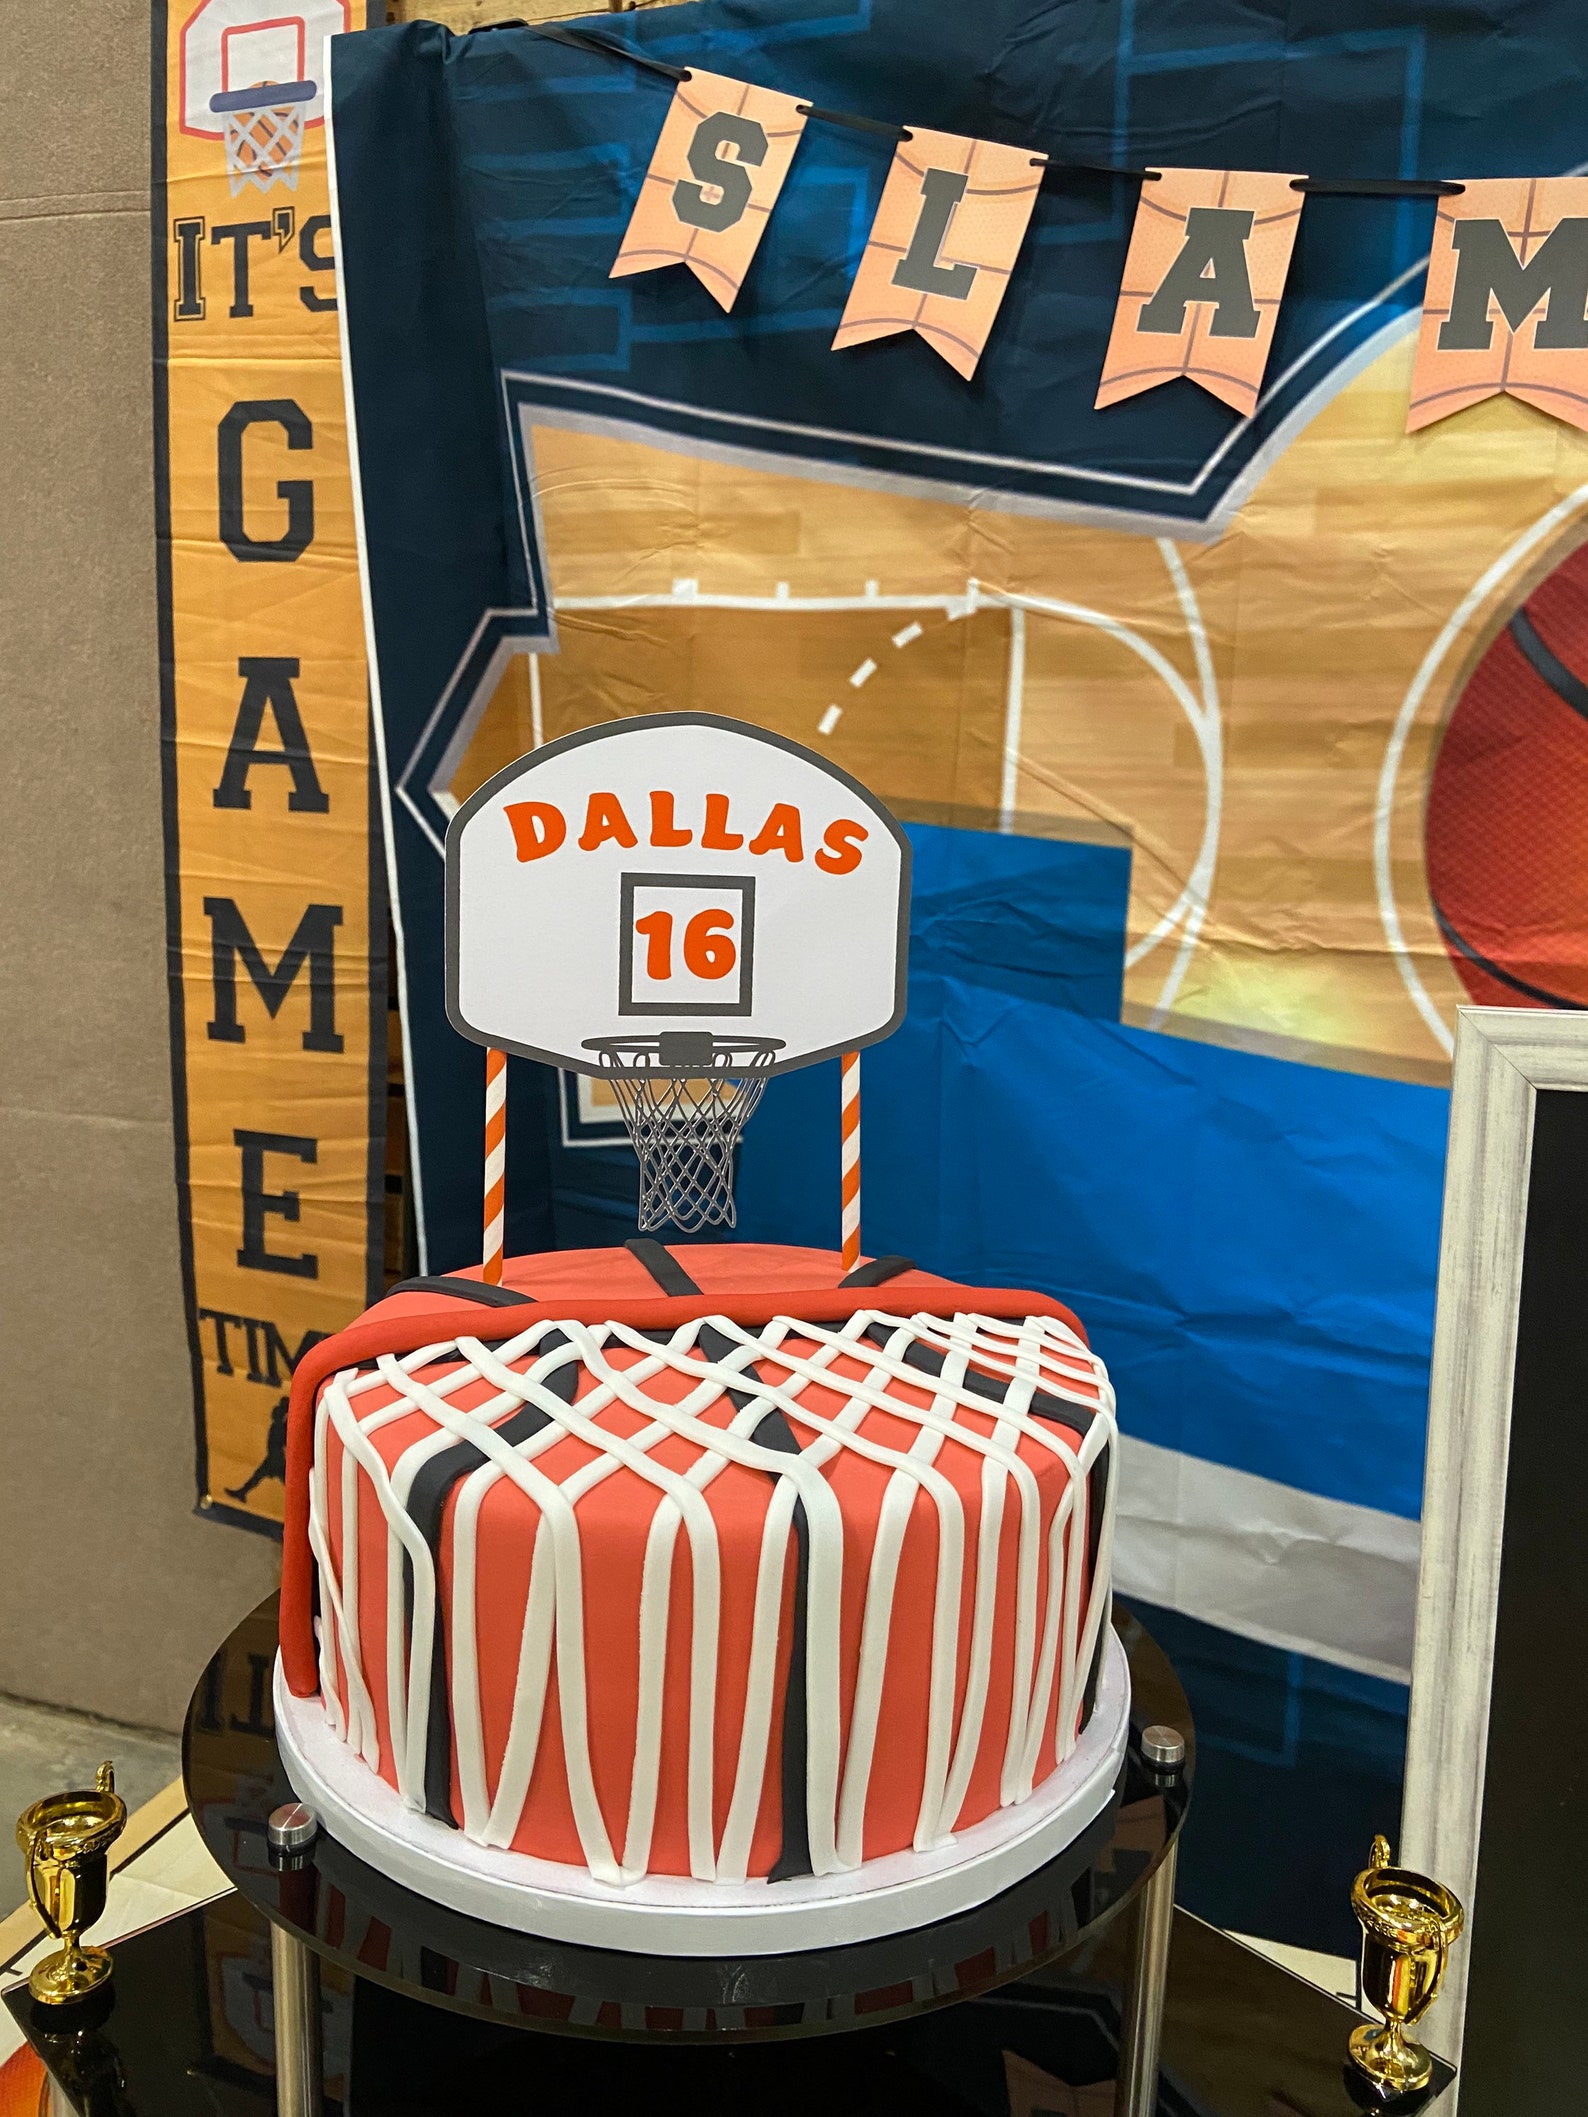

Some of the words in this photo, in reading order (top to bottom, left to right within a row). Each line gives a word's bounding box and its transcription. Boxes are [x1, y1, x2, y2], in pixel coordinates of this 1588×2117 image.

[173, 206, 338, 322] IT'S
[203, 398, 344, 1279] GAME
[503, 790, 869, 875] DALLAS
[635, 908, 736, 980] 16
